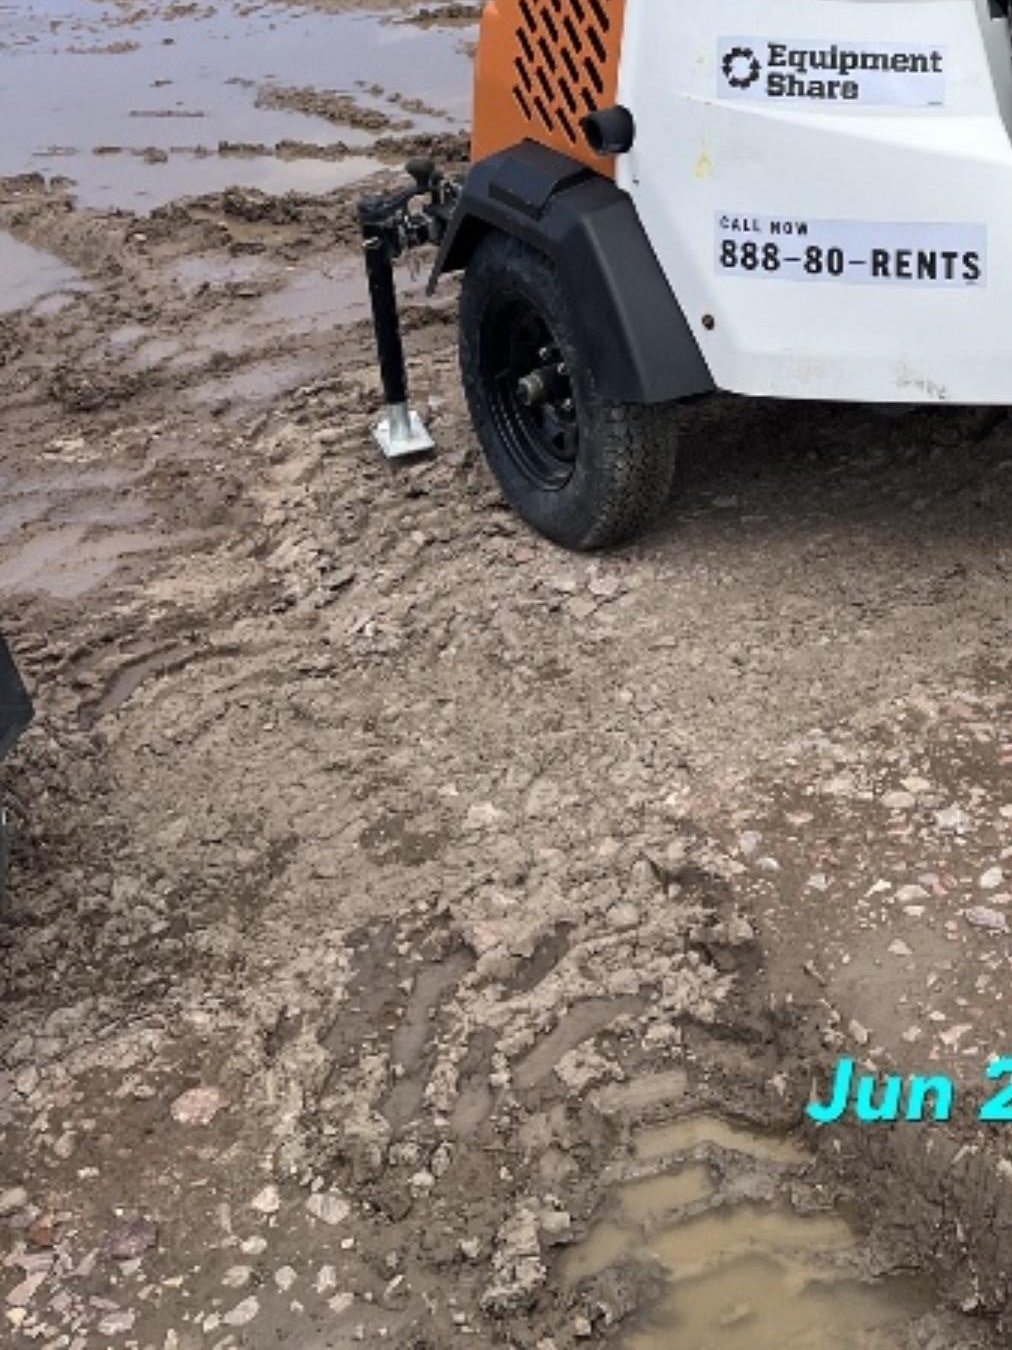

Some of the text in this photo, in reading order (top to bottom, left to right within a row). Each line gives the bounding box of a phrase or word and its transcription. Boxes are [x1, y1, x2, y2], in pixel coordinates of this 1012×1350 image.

[767, 43, 943, 75] Equipment
[767, 71, 859, 99] Share
[719, 216, 808, 236] CALL NOW
[720, 239, 981, 281] 888-80-RENTS
